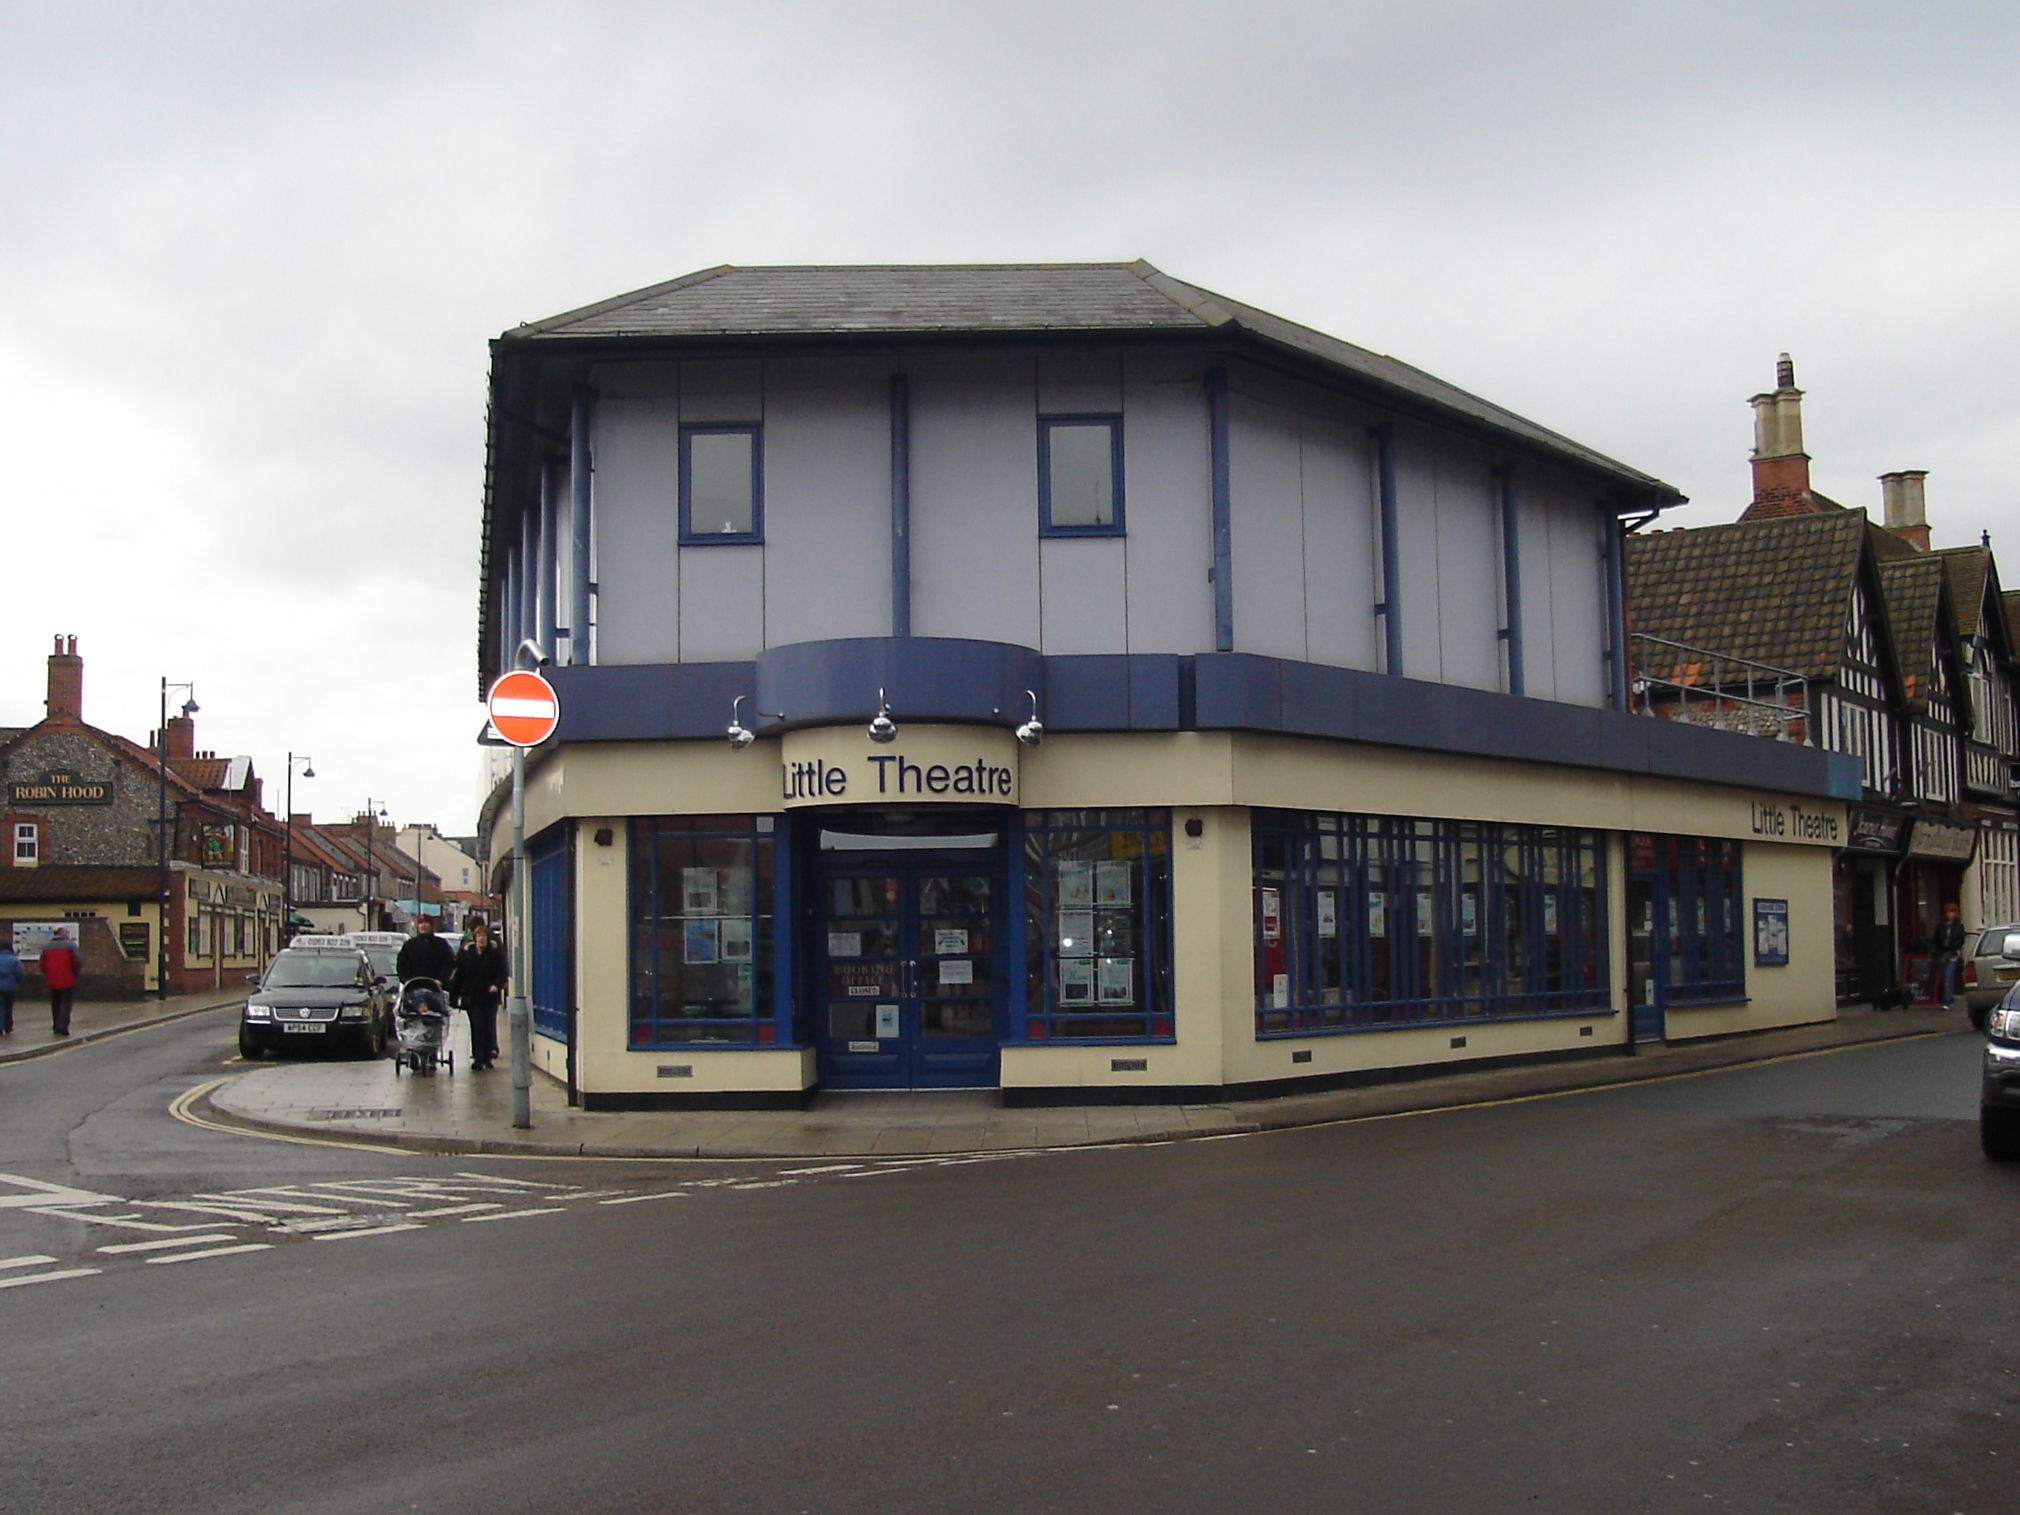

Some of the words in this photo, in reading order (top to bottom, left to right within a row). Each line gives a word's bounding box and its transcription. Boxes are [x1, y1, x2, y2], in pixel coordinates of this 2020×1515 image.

[50, 774, 72, 785] THE
[783, 758, 847, 799] Little
[867, 755, 1012, 797] Theatre
[15, 785, 57, 799] ROBIN
[62, 785, 104, 799] HOOD
[1751, 802, 1785, 836] Little
[1790, 804, 1838, 841] Theatre
[834, 963, 894, 975] BOOKING
[842, 975, 884, 984] OFFICE
